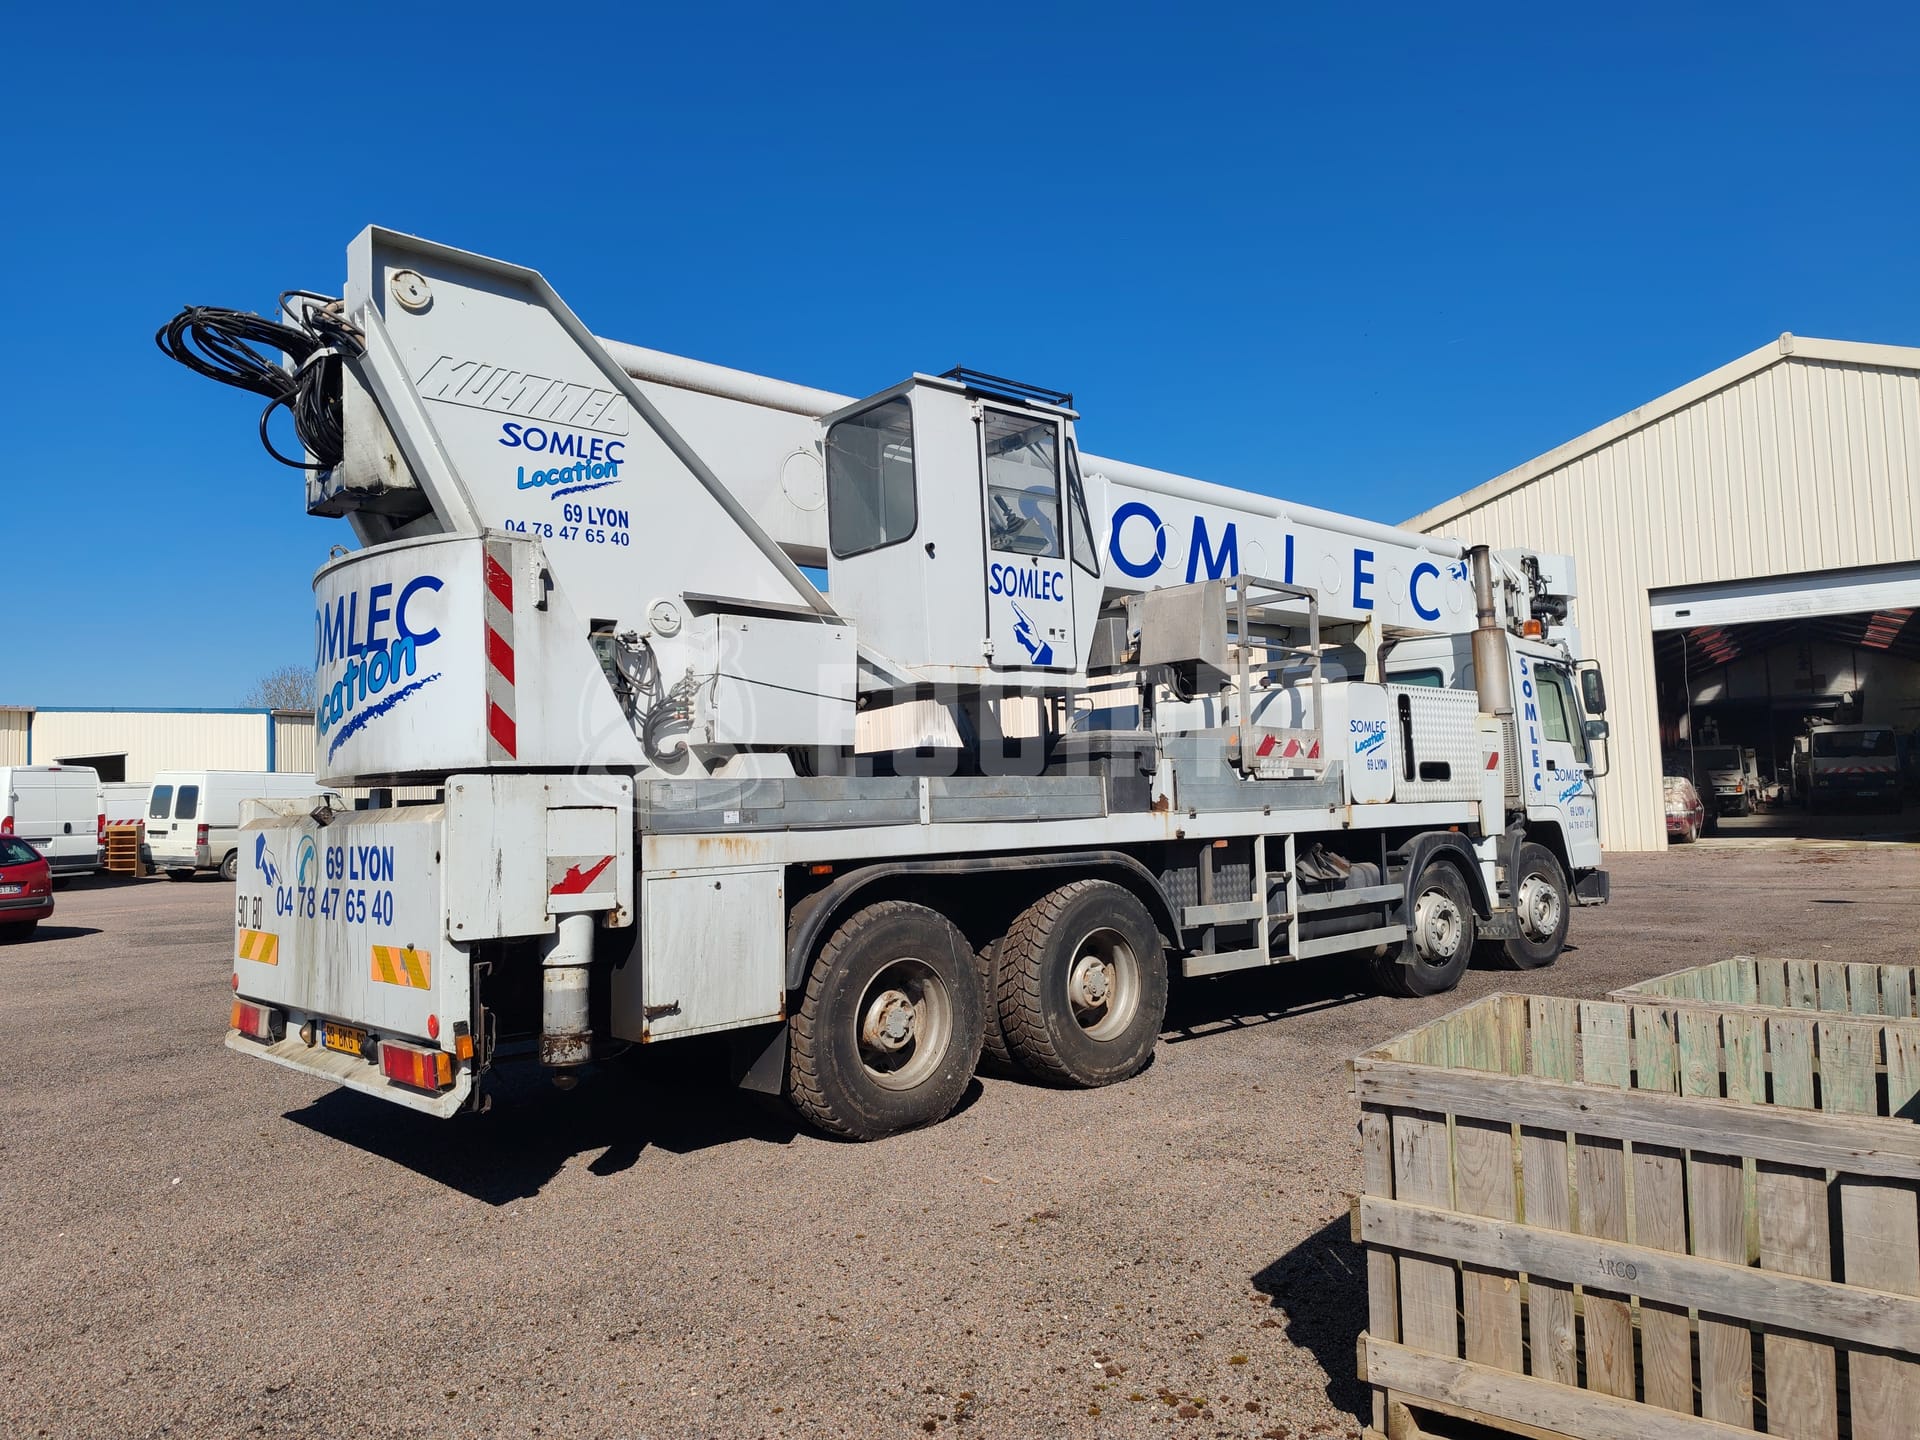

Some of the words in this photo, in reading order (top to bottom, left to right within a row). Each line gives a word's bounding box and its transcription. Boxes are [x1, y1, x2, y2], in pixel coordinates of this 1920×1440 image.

[498, 422, 625, 464] SOMLEC
[517, 459, 618, 489] Location
[563, 503, 583, 523] 69
[587, 506, 629, 528] LYON
[532, 522, 553, 538] 78
[559, 526, 579, 541] 47
[585, 528, 605, 544] 65
[610, 531, 630, 546] 40
[989, 563, 1064, 602] SOMLEC
[1350, 720, 1387, 733] SOMLEC
[1355, 732, 1385, 754] Location
[1374, 759, 1388, 770] LYON
[1554, 768, 1584, 781] SOMLEC
[326, 846, 344, 880] 69
[349, 845, 394, 882] LYON
[237, 895, 248, 928] 90
[252, 896, 263, 930] 80
[276, 886, 293, 917] 04
[298, 886, 316, 919] 78
[320, 887, 340, 921] 47
[345, 888, 366, 924] 65
[371, 890, 394, 927] 40
[1598, 1257, 1637, 1280] ARCO
